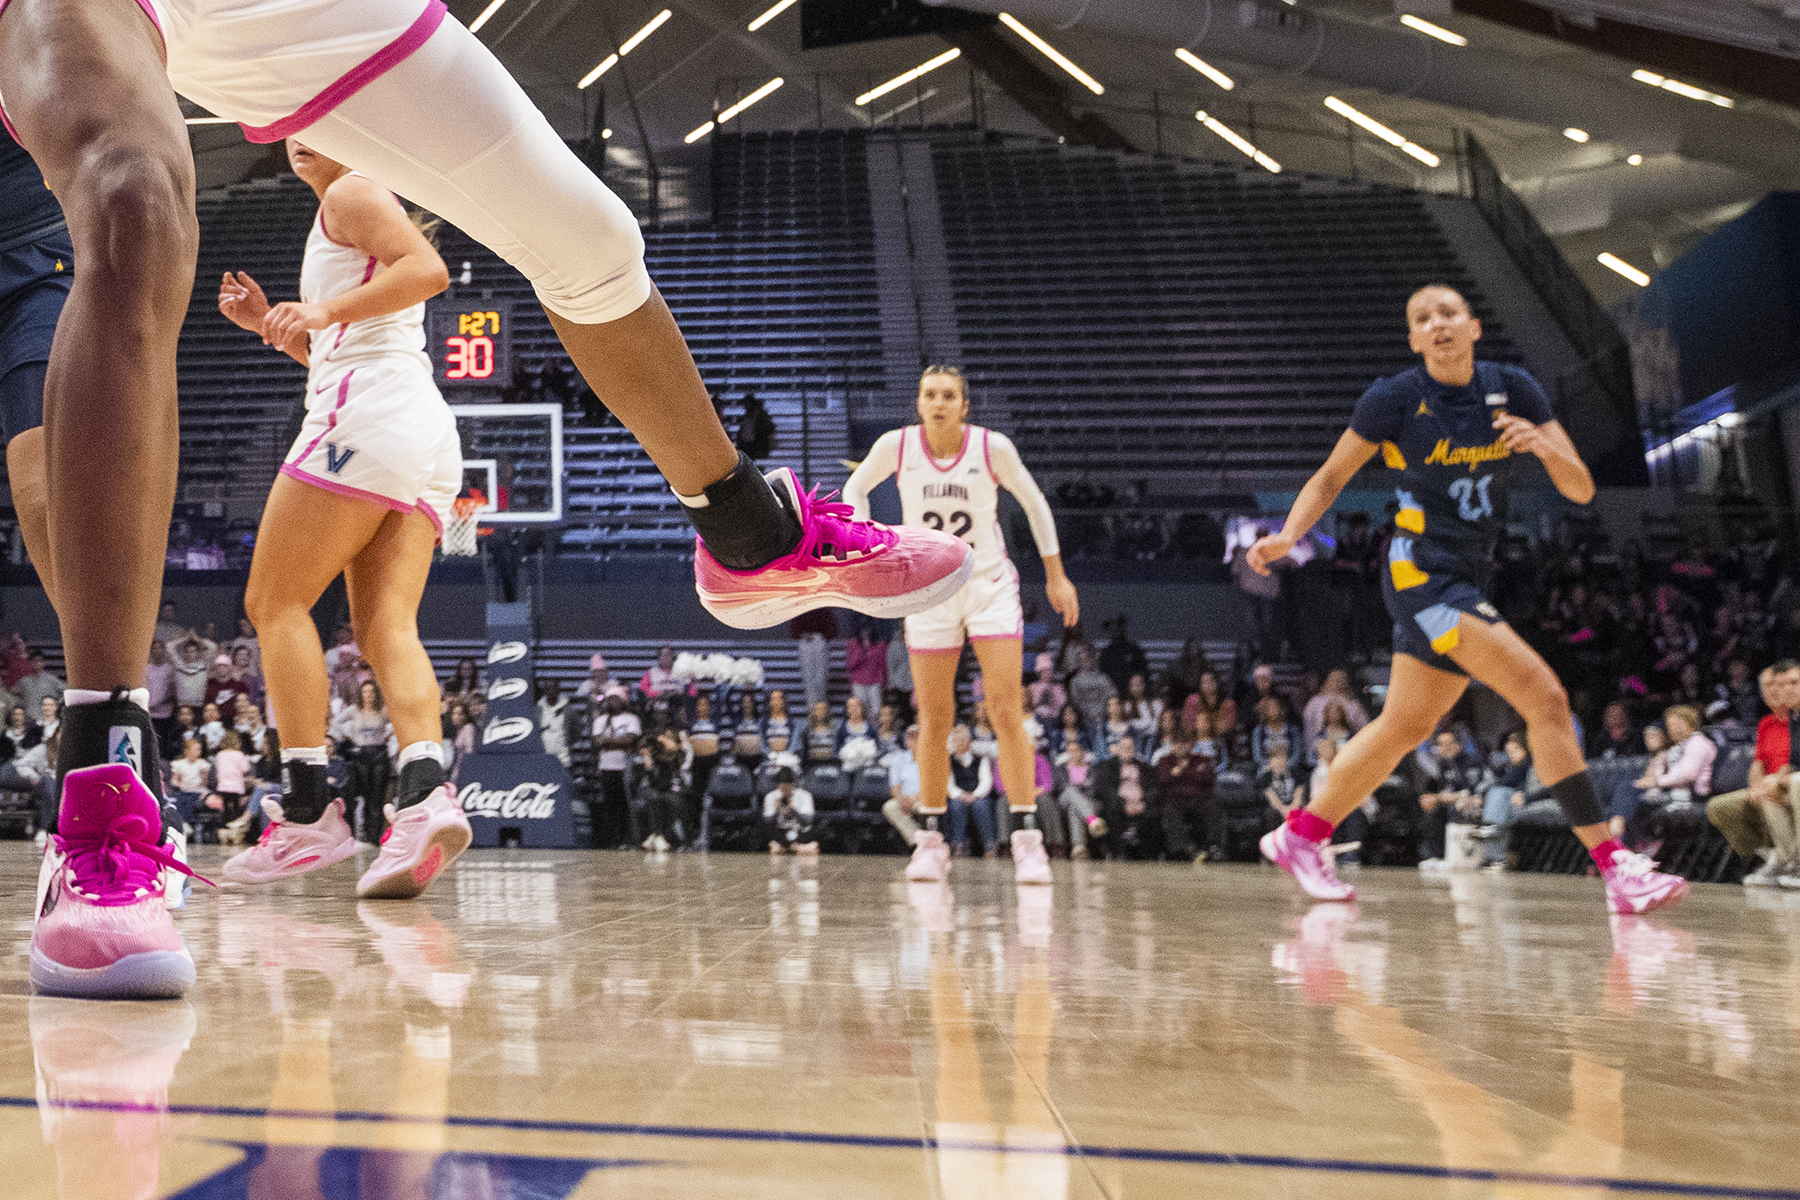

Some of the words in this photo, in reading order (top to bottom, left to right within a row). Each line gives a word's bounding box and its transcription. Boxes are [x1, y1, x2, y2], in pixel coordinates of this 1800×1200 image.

[458, 311, 500, 336] 1:27
[445, 336, 495, 379] 30
[1448, 473, 1494, 522] 21
